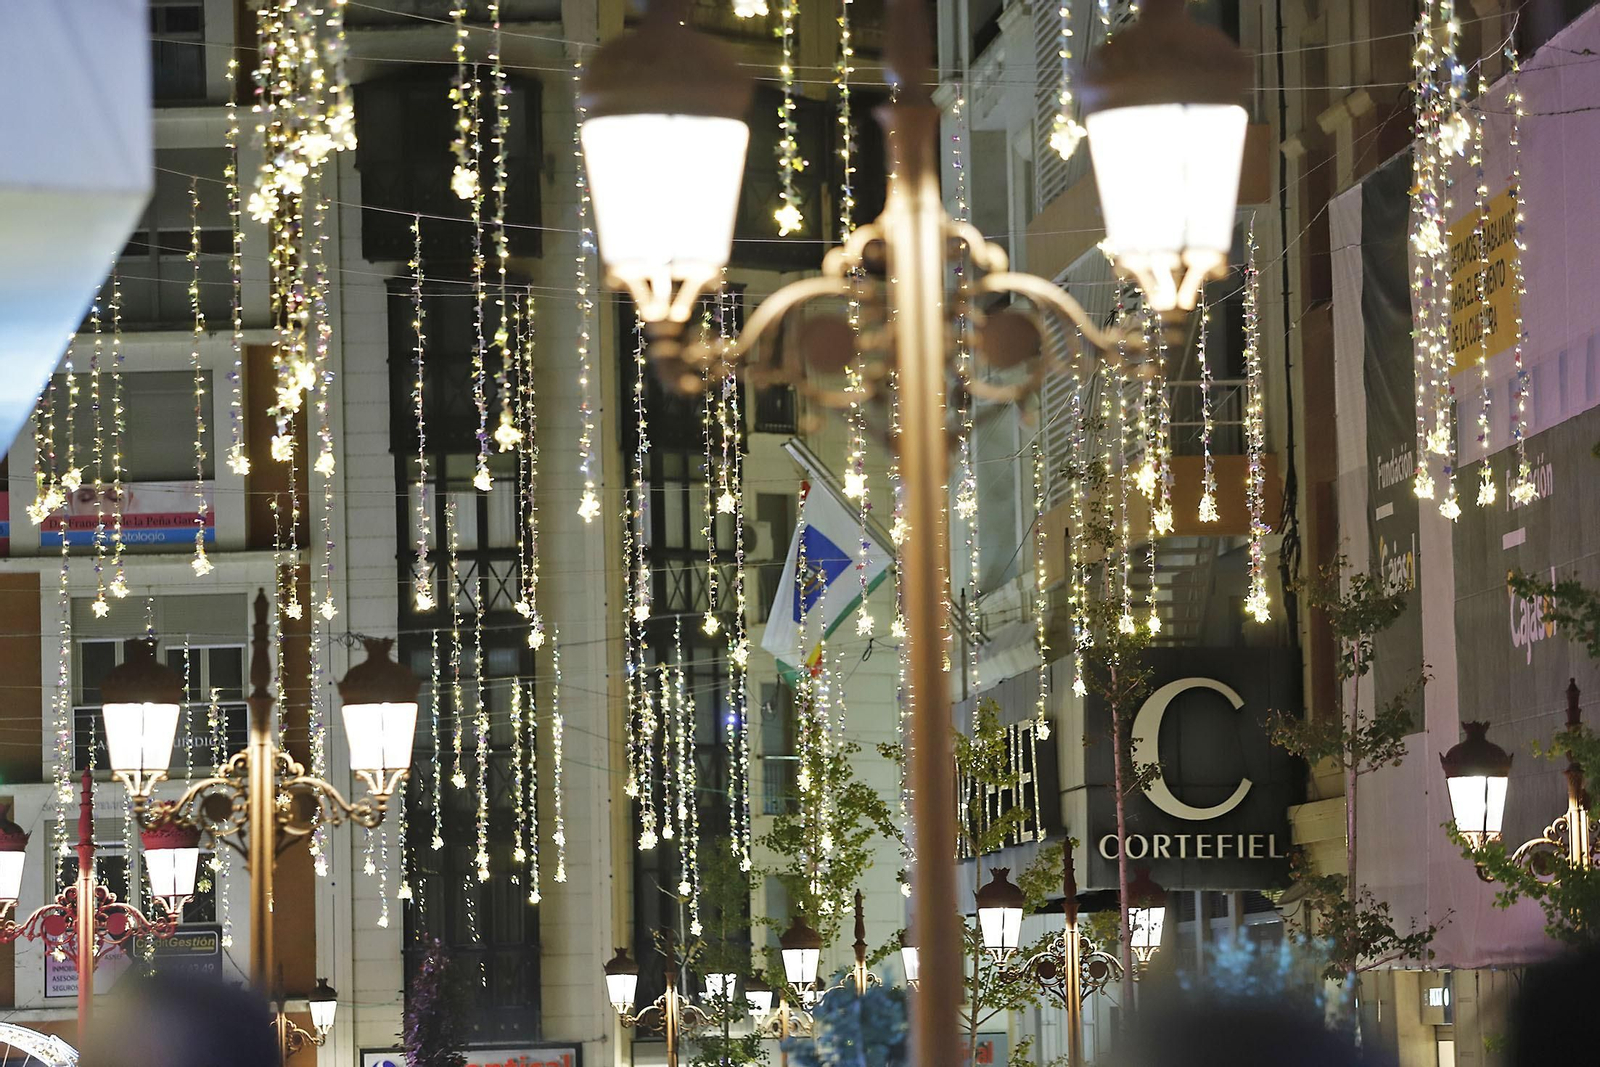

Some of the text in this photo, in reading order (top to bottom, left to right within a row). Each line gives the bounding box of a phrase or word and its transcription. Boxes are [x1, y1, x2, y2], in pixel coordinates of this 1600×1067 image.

[1474, 258, 1505, 300] FMENTO
[1377, 442, 1413, 490] Fundación
[1505, 452, 1552, 512] Fución
[69, 516, 116, 528] Francco
[134, 515, 143, 525] la
[147, 515, 170, 526] Peña
[1131, 677, 1253, 821] C
[1099, 833, 1285, 860] CORTEFIEL
